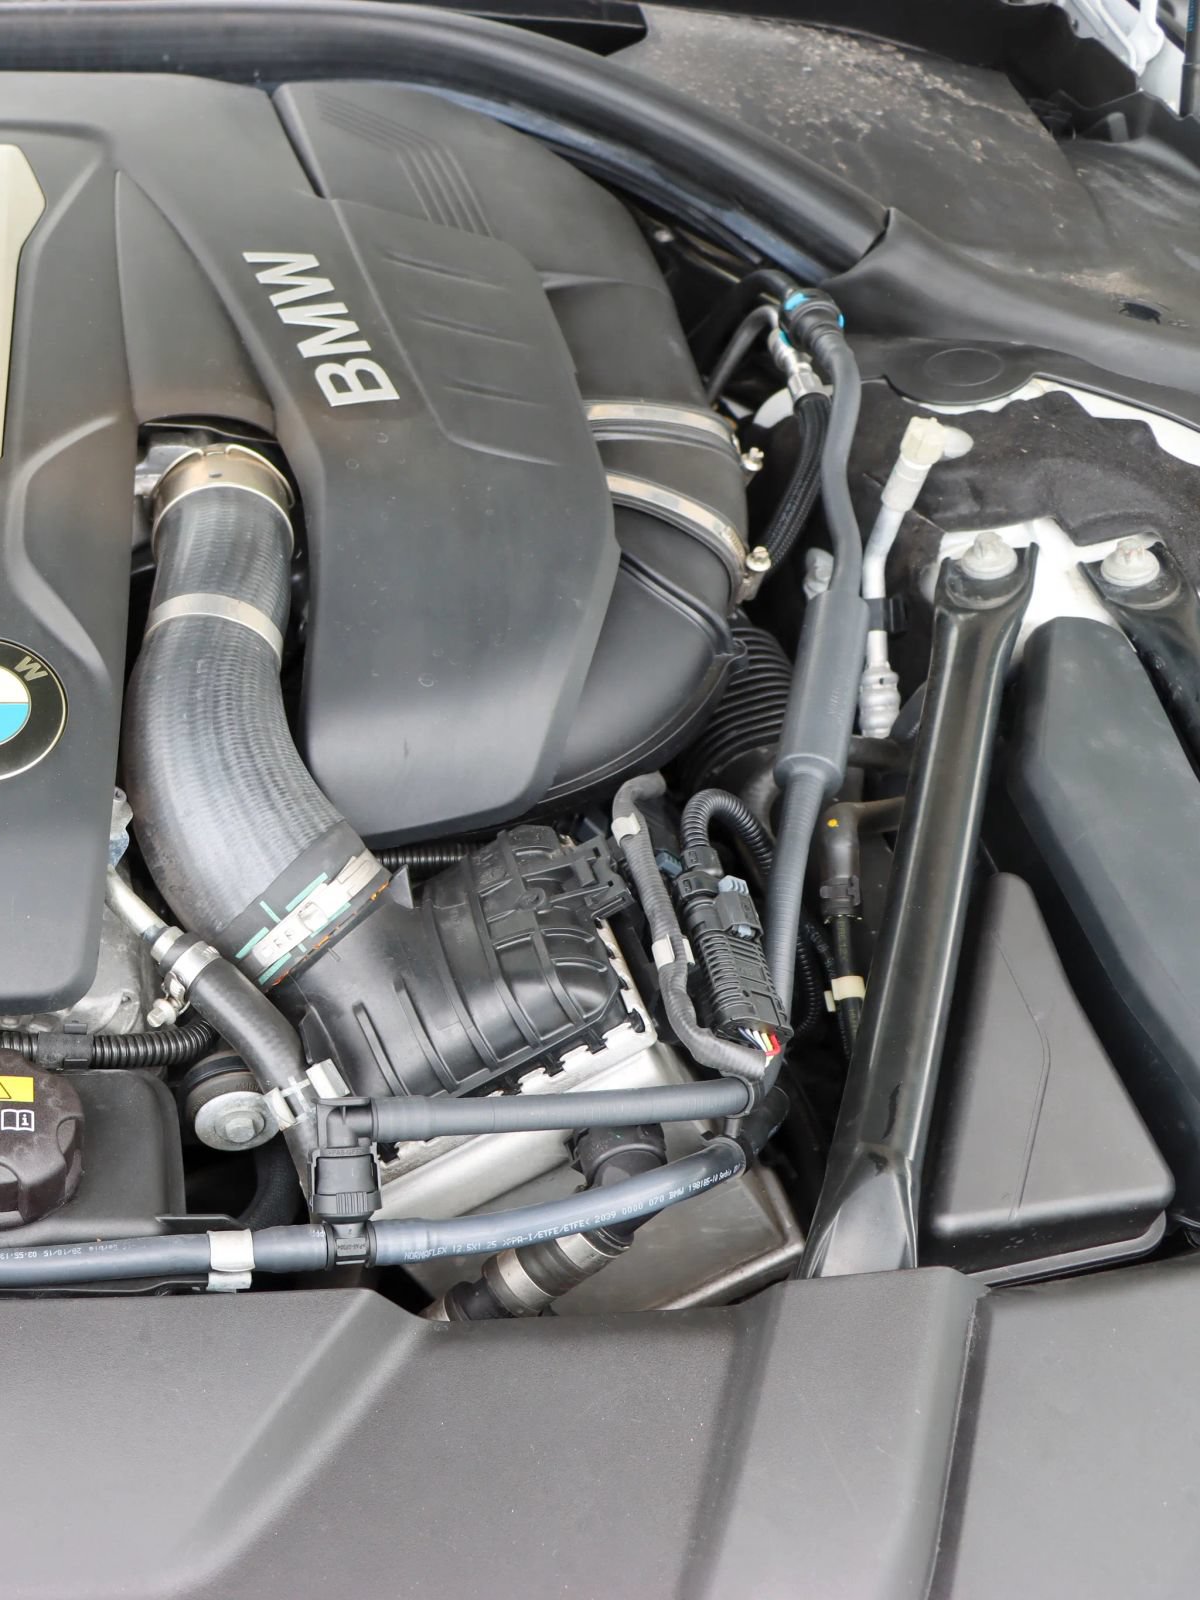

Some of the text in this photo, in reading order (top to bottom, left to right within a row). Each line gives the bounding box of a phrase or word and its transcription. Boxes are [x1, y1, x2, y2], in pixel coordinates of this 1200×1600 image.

[242, 251, 401, 407] BMW
[403, 1246, 447, 1260] NORMAFLEX
[595, 1210, 617, 1224] 2039
[622, 1202, 644, 1216] 0000
[648, 1193, 665, 1208] 070
[668, 1186, 685, 1201] BMW
